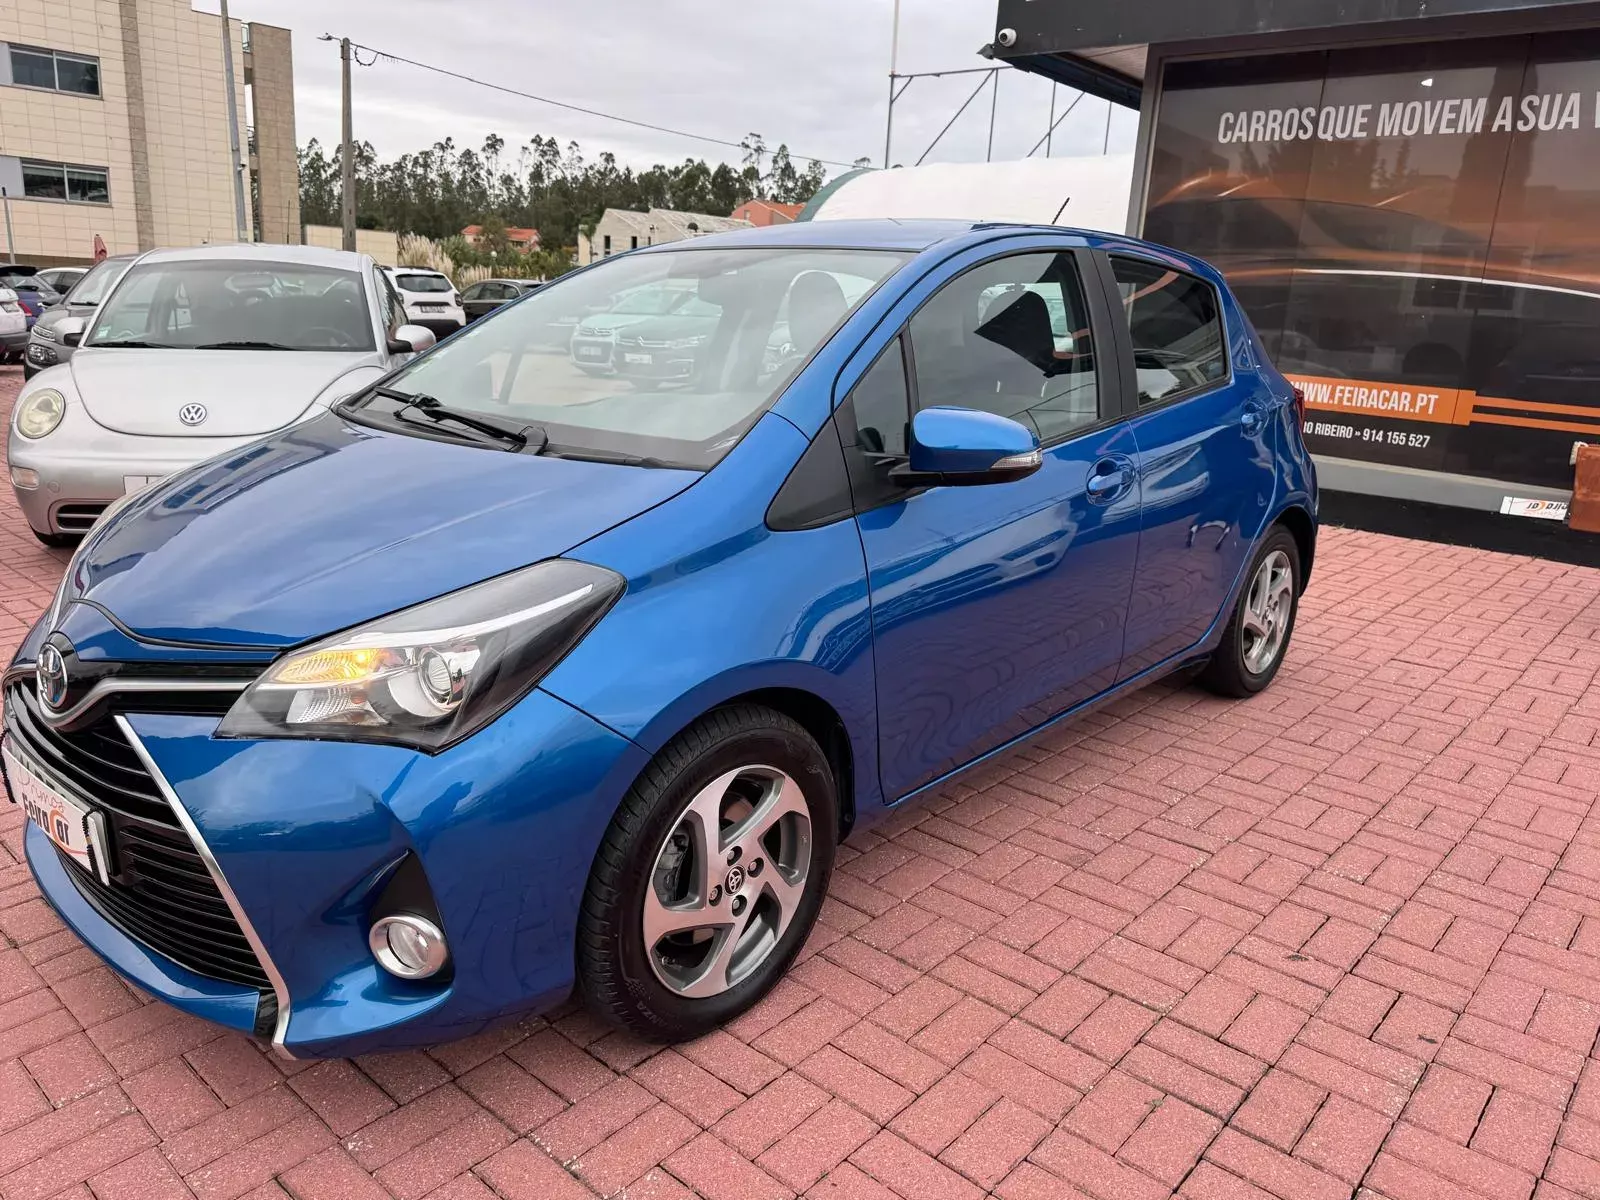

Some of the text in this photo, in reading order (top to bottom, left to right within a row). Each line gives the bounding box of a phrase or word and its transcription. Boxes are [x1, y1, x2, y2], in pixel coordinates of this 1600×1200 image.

[1217, 106, 1315, 144] CARROS
[1317, 104, 1373, 142] QUE
[1375, 97, 1488, 138] MOVEM
[1491, 96, 1513, 133] A
[1516, 92, 1581, 132] SUA
[1314, 422, 1353, 439] RIBEIRO
[1362, 428, 1384, 443] 914
[1386, 431, 1406, 446] 155
[1408, 433, 1431, 448] 527
